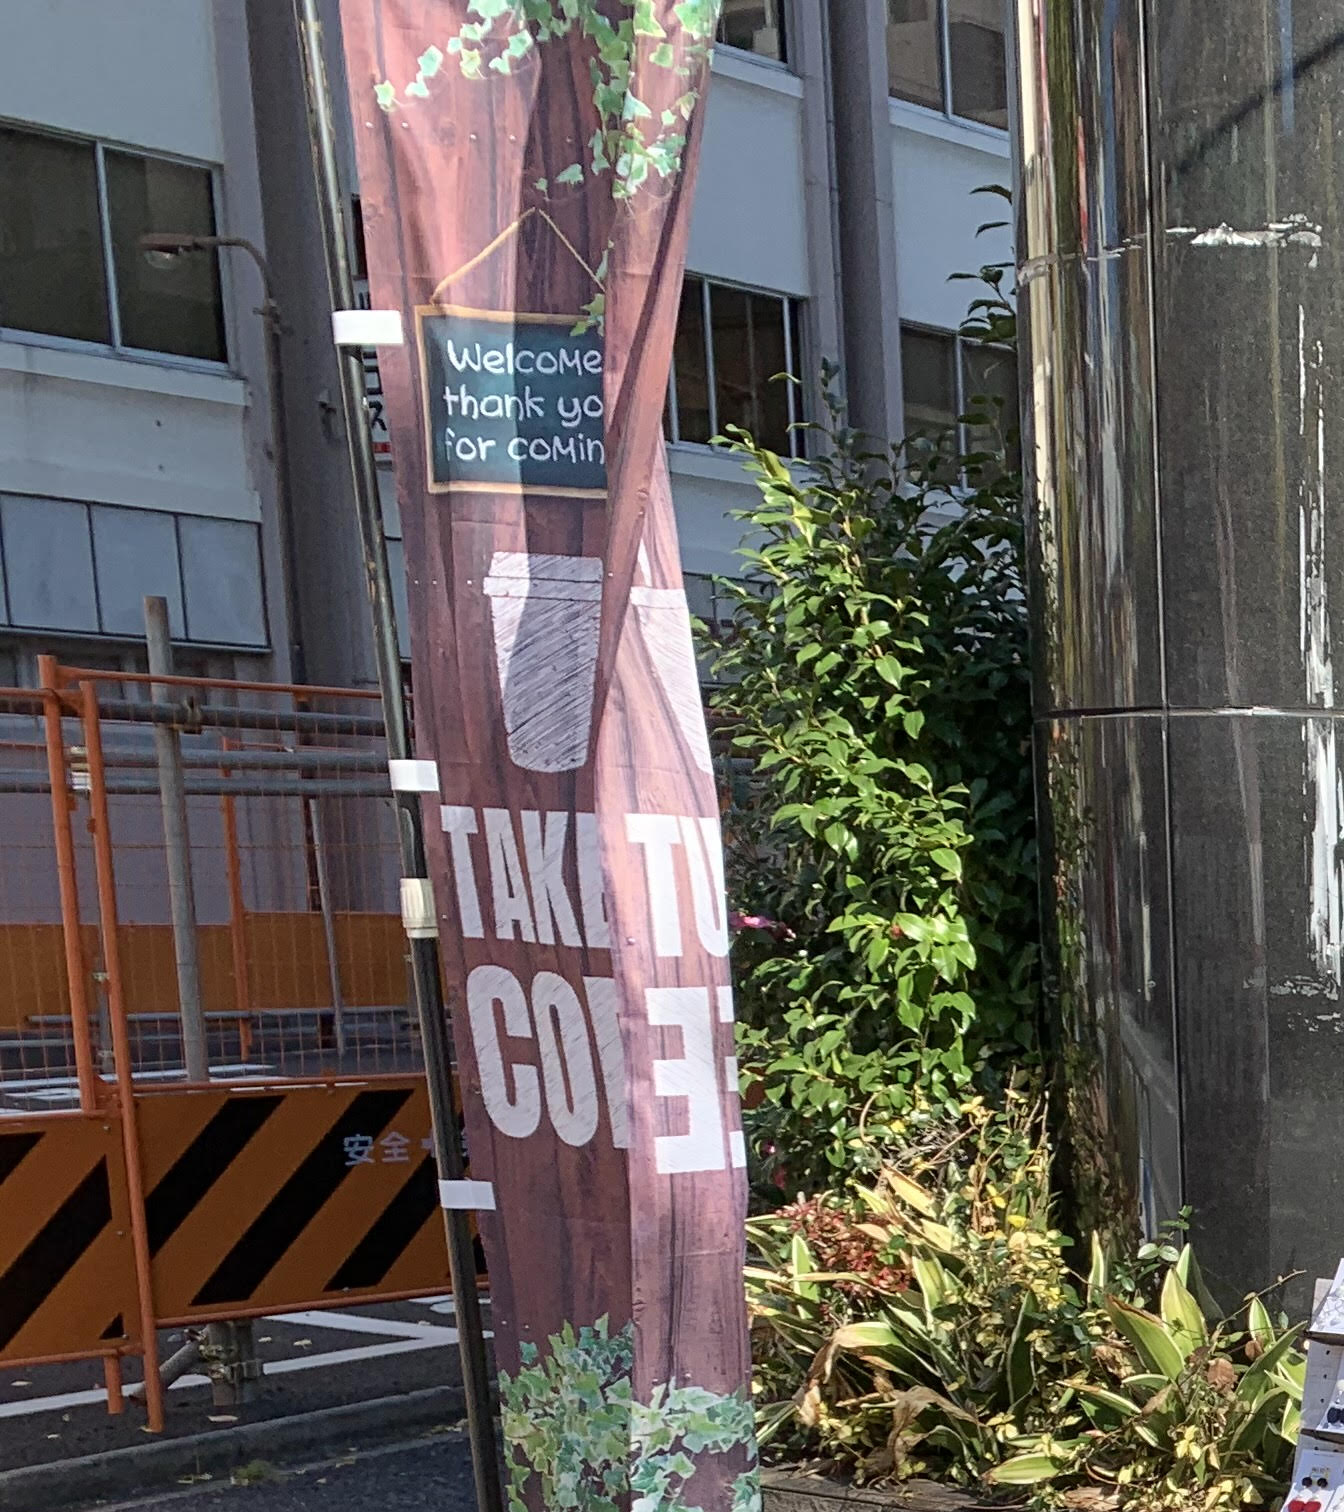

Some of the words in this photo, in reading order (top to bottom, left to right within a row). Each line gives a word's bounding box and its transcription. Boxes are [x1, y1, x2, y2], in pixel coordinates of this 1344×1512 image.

[447, 340, 602, 376] Welcome
[442, 384, 545, 421] thank
[557, 394, 605, 428] yo
[444, 428, 497, 461] for
[507, 433, 606, 465] comin
